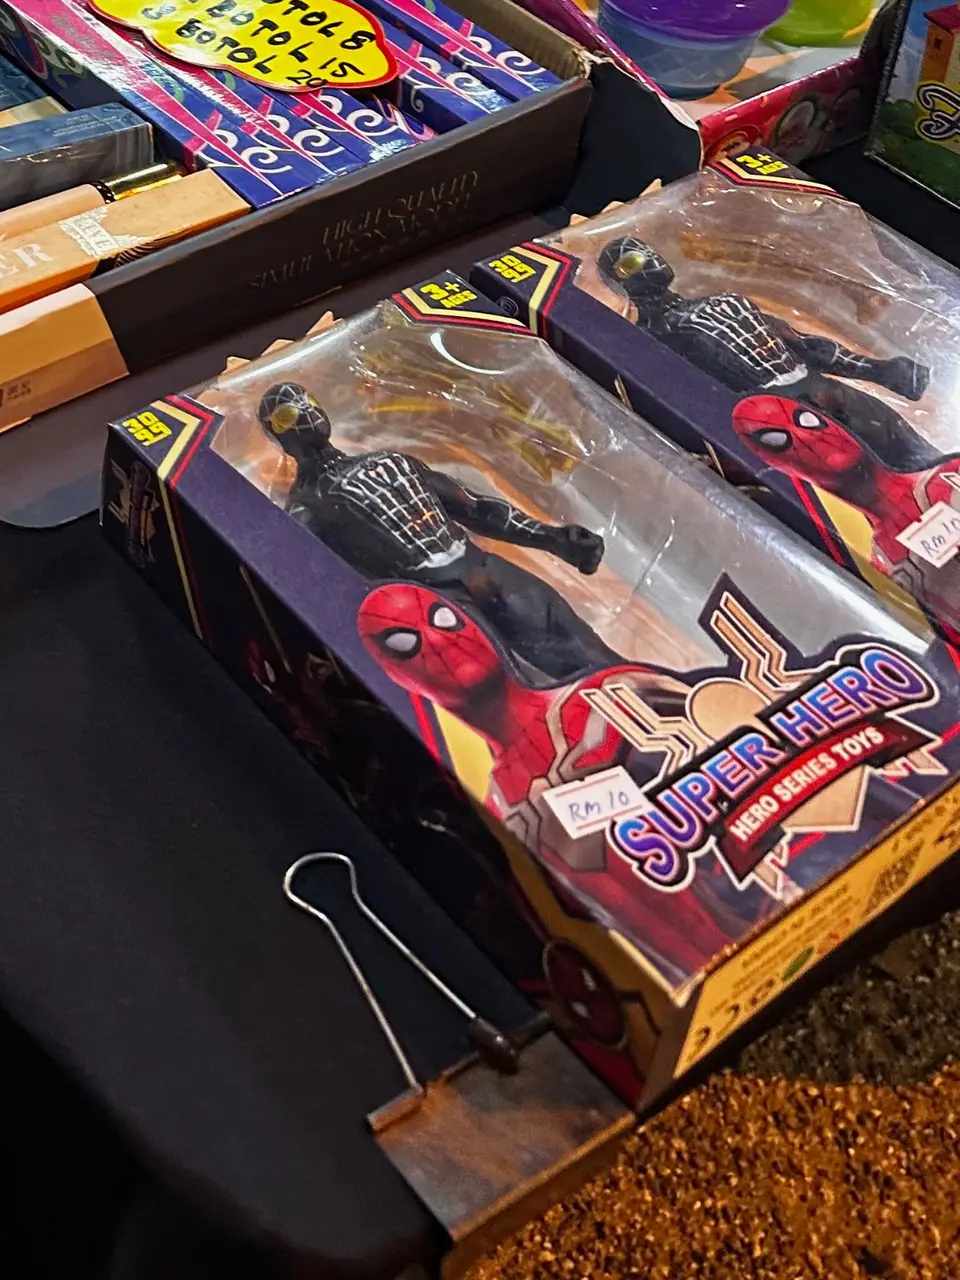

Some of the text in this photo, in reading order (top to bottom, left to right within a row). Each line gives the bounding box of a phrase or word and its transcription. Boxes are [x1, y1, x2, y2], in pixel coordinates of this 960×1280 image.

[176, 17, 277, 75] BOTOL
[287, 69, 329, 89] 20
[736, 153, 773, 169] 3+
[420, 281, 461, 300] 3+
[440, 290, 478, 308] AGES
[614, 732, 781, 882] SUPER
[770, 646, 931, 746] HERO
[729, 725, 885, 842] HERO SERIES TOYS
